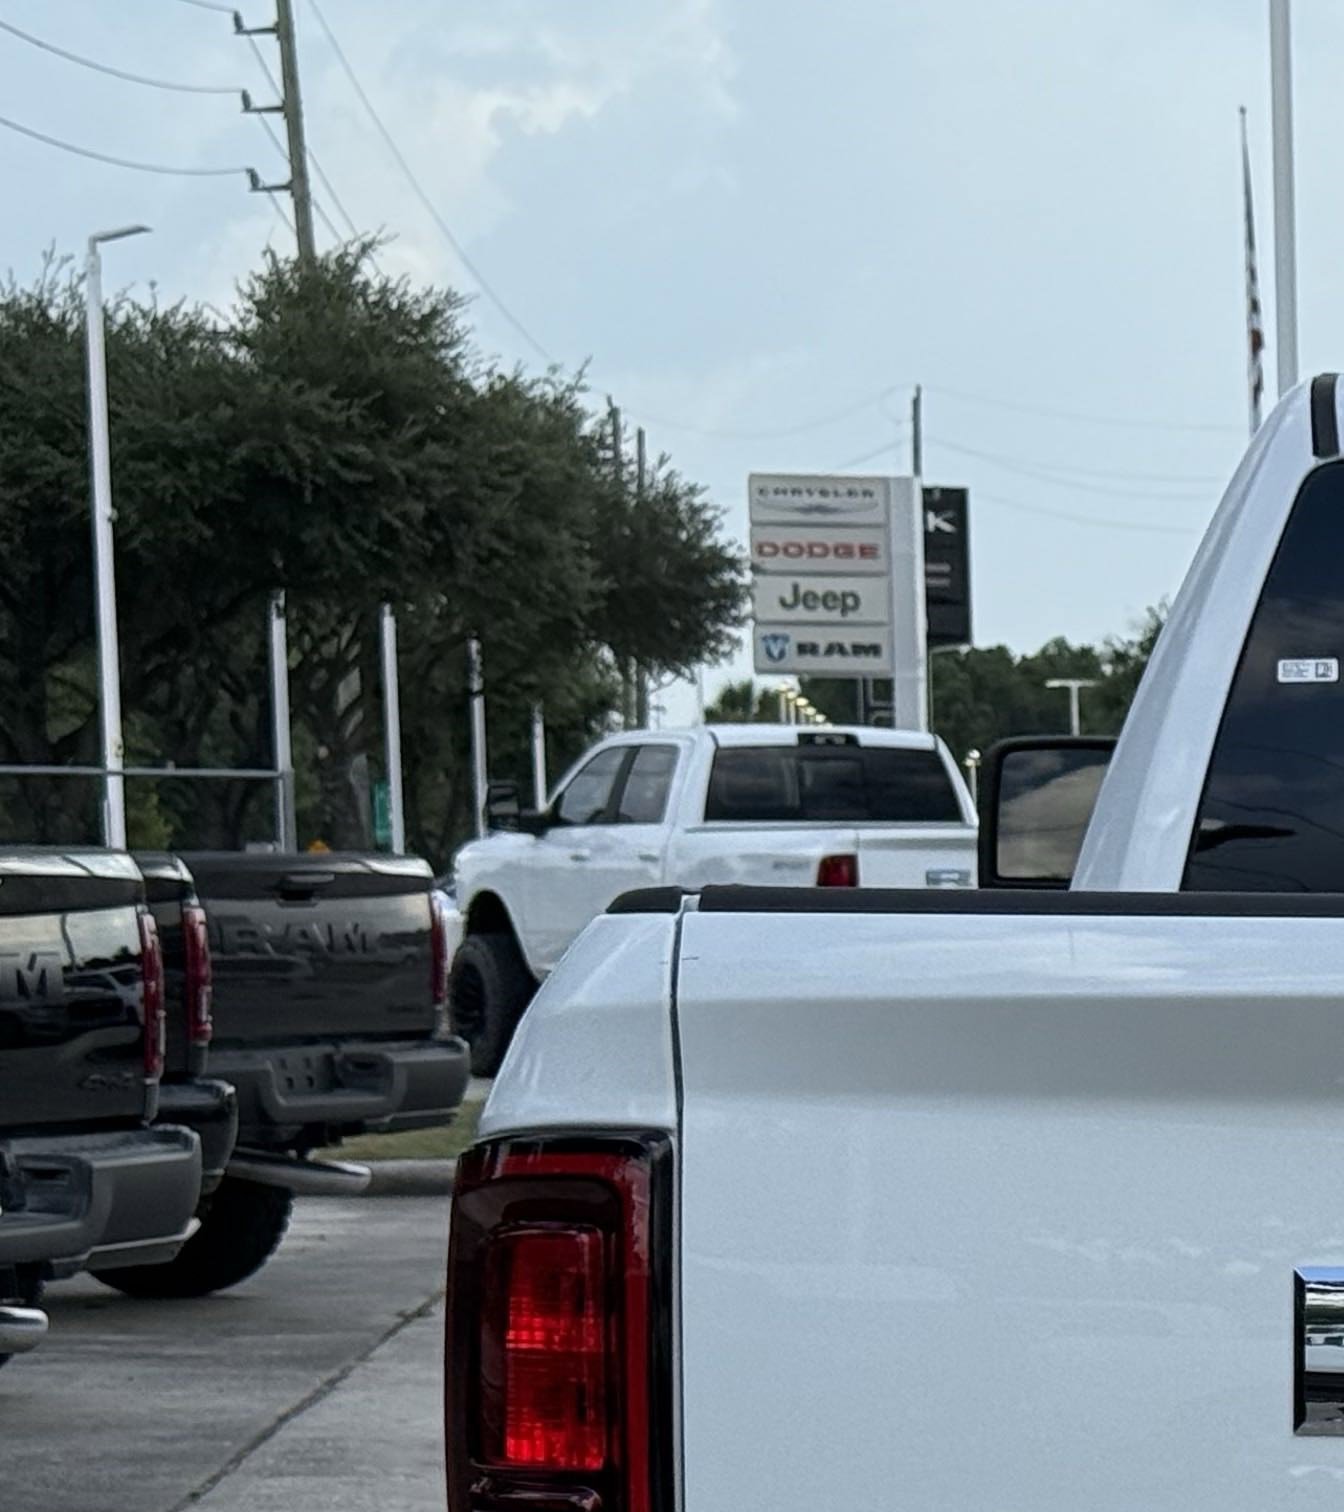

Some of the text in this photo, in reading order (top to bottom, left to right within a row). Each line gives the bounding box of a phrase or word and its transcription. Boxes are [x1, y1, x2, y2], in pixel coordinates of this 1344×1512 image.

[756, 541, 881, 559] DODGE
[779, 582, 861, 616] Jeep
[797, 641, 882, 658] RAM
